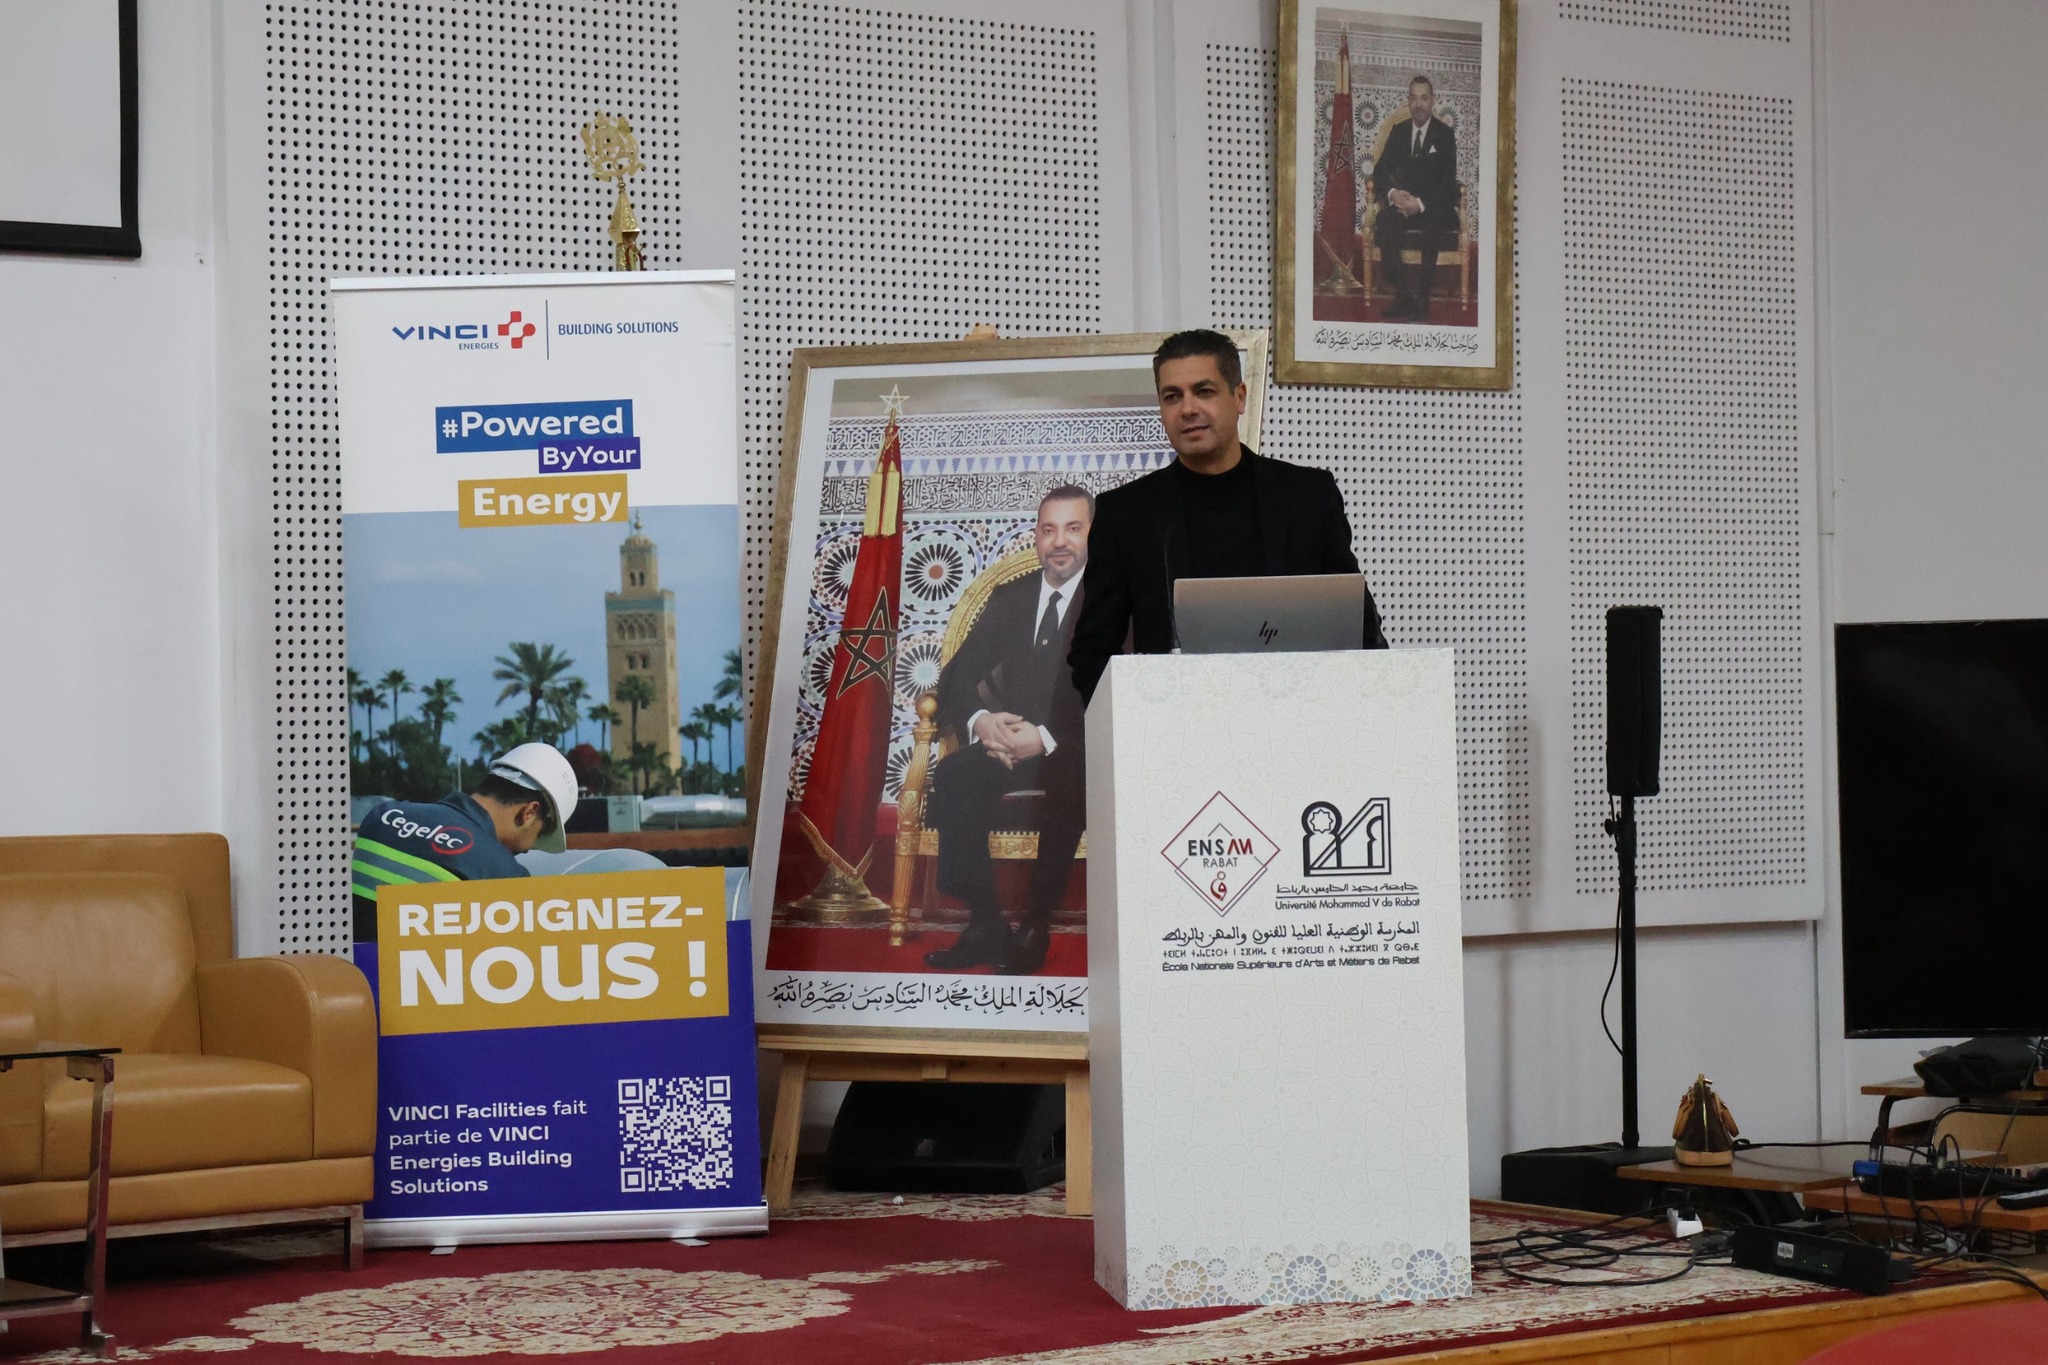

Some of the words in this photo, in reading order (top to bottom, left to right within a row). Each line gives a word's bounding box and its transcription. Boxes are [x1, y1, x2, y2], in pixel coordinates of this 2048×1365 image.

[392, 324, 488, 341] VINCI
[558, 322, 614, 336] BUILDING
[616, 321, 679, 334] SOLUTIONS
[1313, 325, 1329, 349] الله
[458, 342, 499, 350] ENERGIES
[1328, 328, 1352, 352] نصره
[1351, 330, 1386, 352] السادس
[1386, 329, 1403, 351] محمد
[1403, 332, 1424, 352] الملك
[1450, 332, 1479, 356] صاحب
[441, 406, 624, 439] #Powered
[542, 446, 637, 471] ByYour
[473, 486, 623, 523] Energy
[380, 807, 464, 849] Cegelec
[1203, 857, 1238, 868] RABAT
[1276, 883, 1309, 895] بالرباط
[1310, 883, 1349, 894] الخامس
[1351, 884, 1378, 893] محمد
[1379, 881, 1418, 891] جامعة
[1275, 900, 1317, 910] Université
[1319, 897, 1370, 909] Mohammed
[1372, 898, 1379, 907] V
[1381, 897, 1392, 907] de
[1395, 897, 1420, 907] Rabat
[398, 895, 703, 937] REJOIGNEZ-
[1162, 927, 1204, 947] بالرباط
[1209, 926, 1247, 946] والمهن
[1252, 925, 1287, 945] للفنون
[1291, 924, 1322, 940] العليا
[1326, 922, 1373, 942] الوطنية
[1376, 921, 1420, 942] المدرسة
[399, 941, 659, 1007] NOUS
[687, 940, 707, 998] !
[1162, 961, 1189, 972] École
[1191, 960, 1235, 971] Nationale
[1237, 960, 1293, 970] Supérieure
[1327, 959, 1336, 967] et
[1338, 957, 1375, 966] Métiers
[1377, 957, 1390, 965] de
[1392, 955, 1420, 964] Rabat
[766, 975, 802, 1008] الله
[800, 980, 854, 1013] نصره
[852, 981, 931, 1013] السادس
[935, 979, 973, 1012] محمد
[973, 984, 1022, 1015] الملك
[1024, 983, 1088, 1015] لجلالة
[388, 1104, 449, 1122] VINCI
[455, 1101, 547, 1119] Facilities
[552, 1100, 588, 1116] fait
[389, 1129, 451, 1151] partie
[457, 1128, 483, 1144] de
[488, 1125, 549, 1142] VINCI
[390, 1153, 482, 1174] Energies
[488, 1150, 572, 1168] Building
[390, 1178, 489, 1195] Solutions
